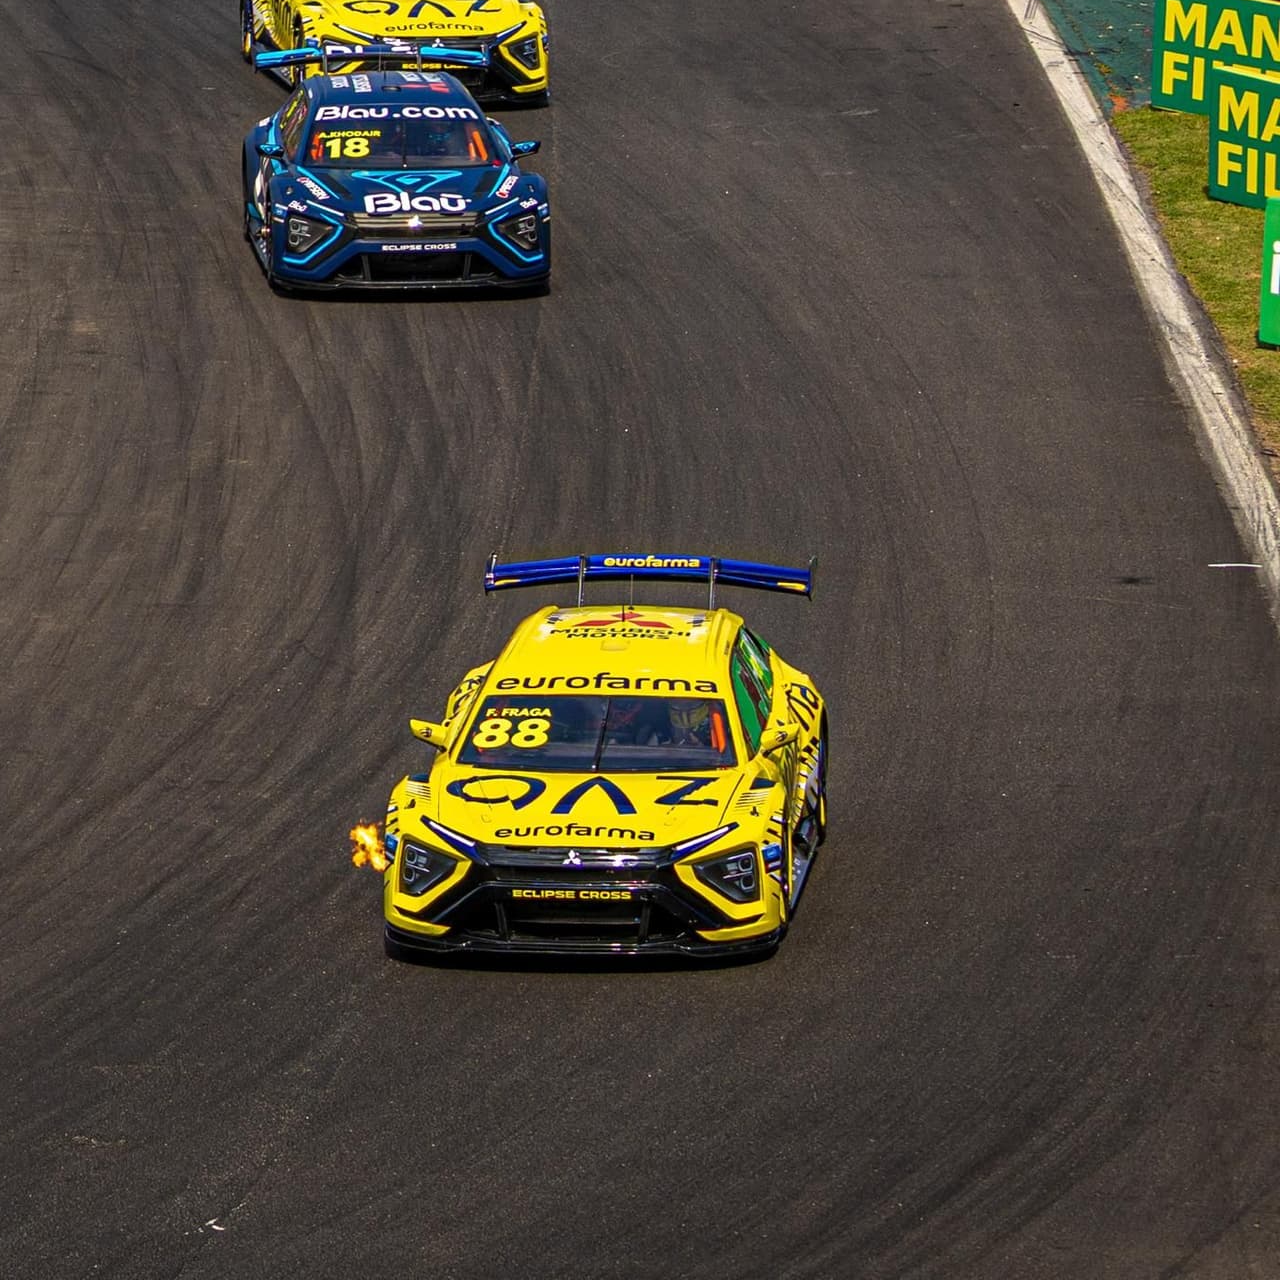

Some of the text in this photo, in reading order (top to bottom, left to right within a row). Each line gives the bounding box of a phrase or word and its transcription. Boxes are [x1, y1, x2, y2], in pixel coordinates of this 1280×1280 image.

[385, 21, 485, 32] eurofarma
[325, 137, 371, 159] 18
[382, 243, 457, 251] ECLIPSE CROSS
[603, 555, 701, 568] eurofarma
[550, 627, 691, 637] MITSUBISHI
[566, 631, 670, 640] MOTORS
[495, 672, 719, 693] eurofarma
[485, 707, 552, 718] F. FRAGA
[472, 718, 552, 749] 88
[494, 822, 656, 841] eurofarma
[512, 888, 632, 901] ECLIPSE CROSS
